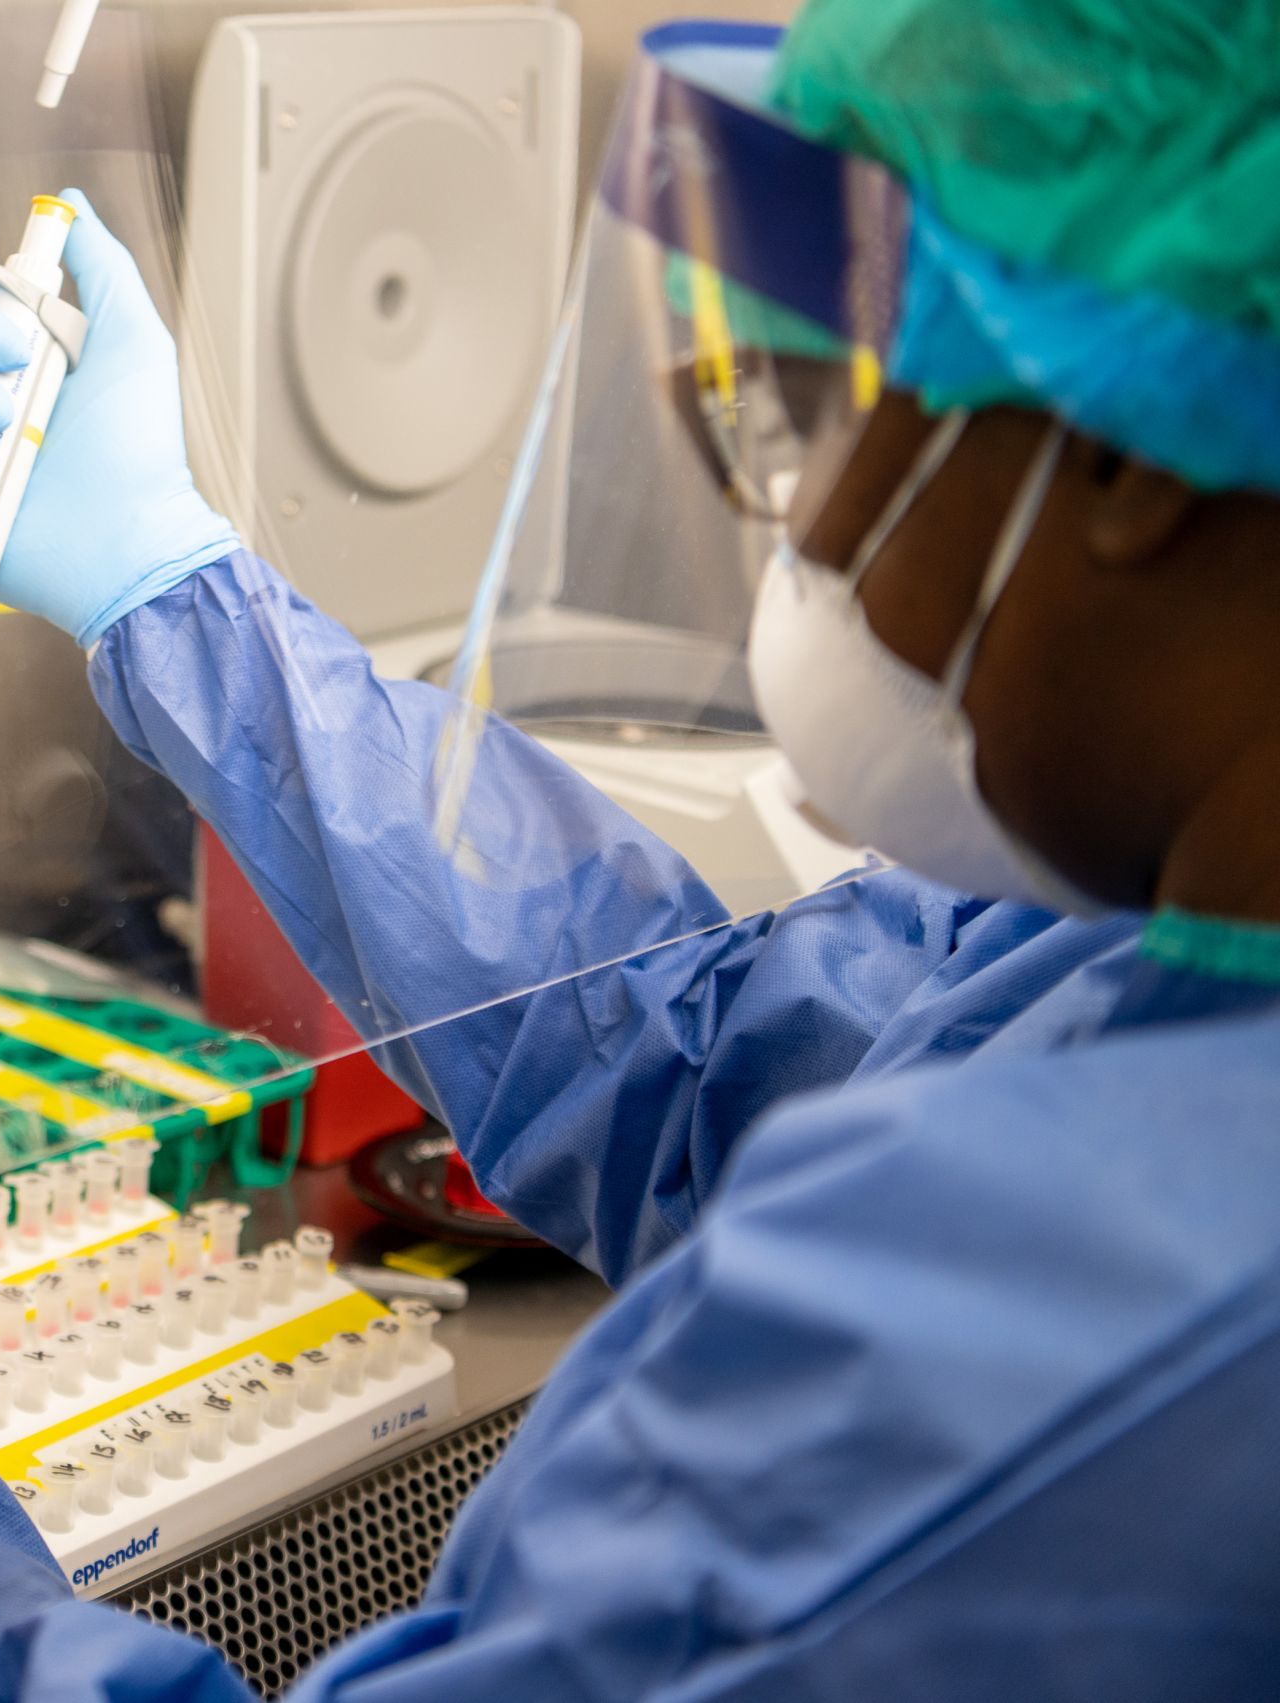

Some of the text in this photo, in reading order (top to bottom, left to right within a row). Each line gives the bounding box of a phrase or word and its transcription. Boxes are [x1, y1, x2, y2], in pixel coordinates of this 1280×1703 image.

[23, 1351, 55, 1361] 4
[51, 1463, 85, 1476] 14
[90, 1444, 116, 1459] 15
[125, 1428, 152, 1443] 16
[240, 1378, 268, 1394] 19
[372, 1422, 389, 1441] 1.5
[73, 1527, 159, 1586] eppendorf
